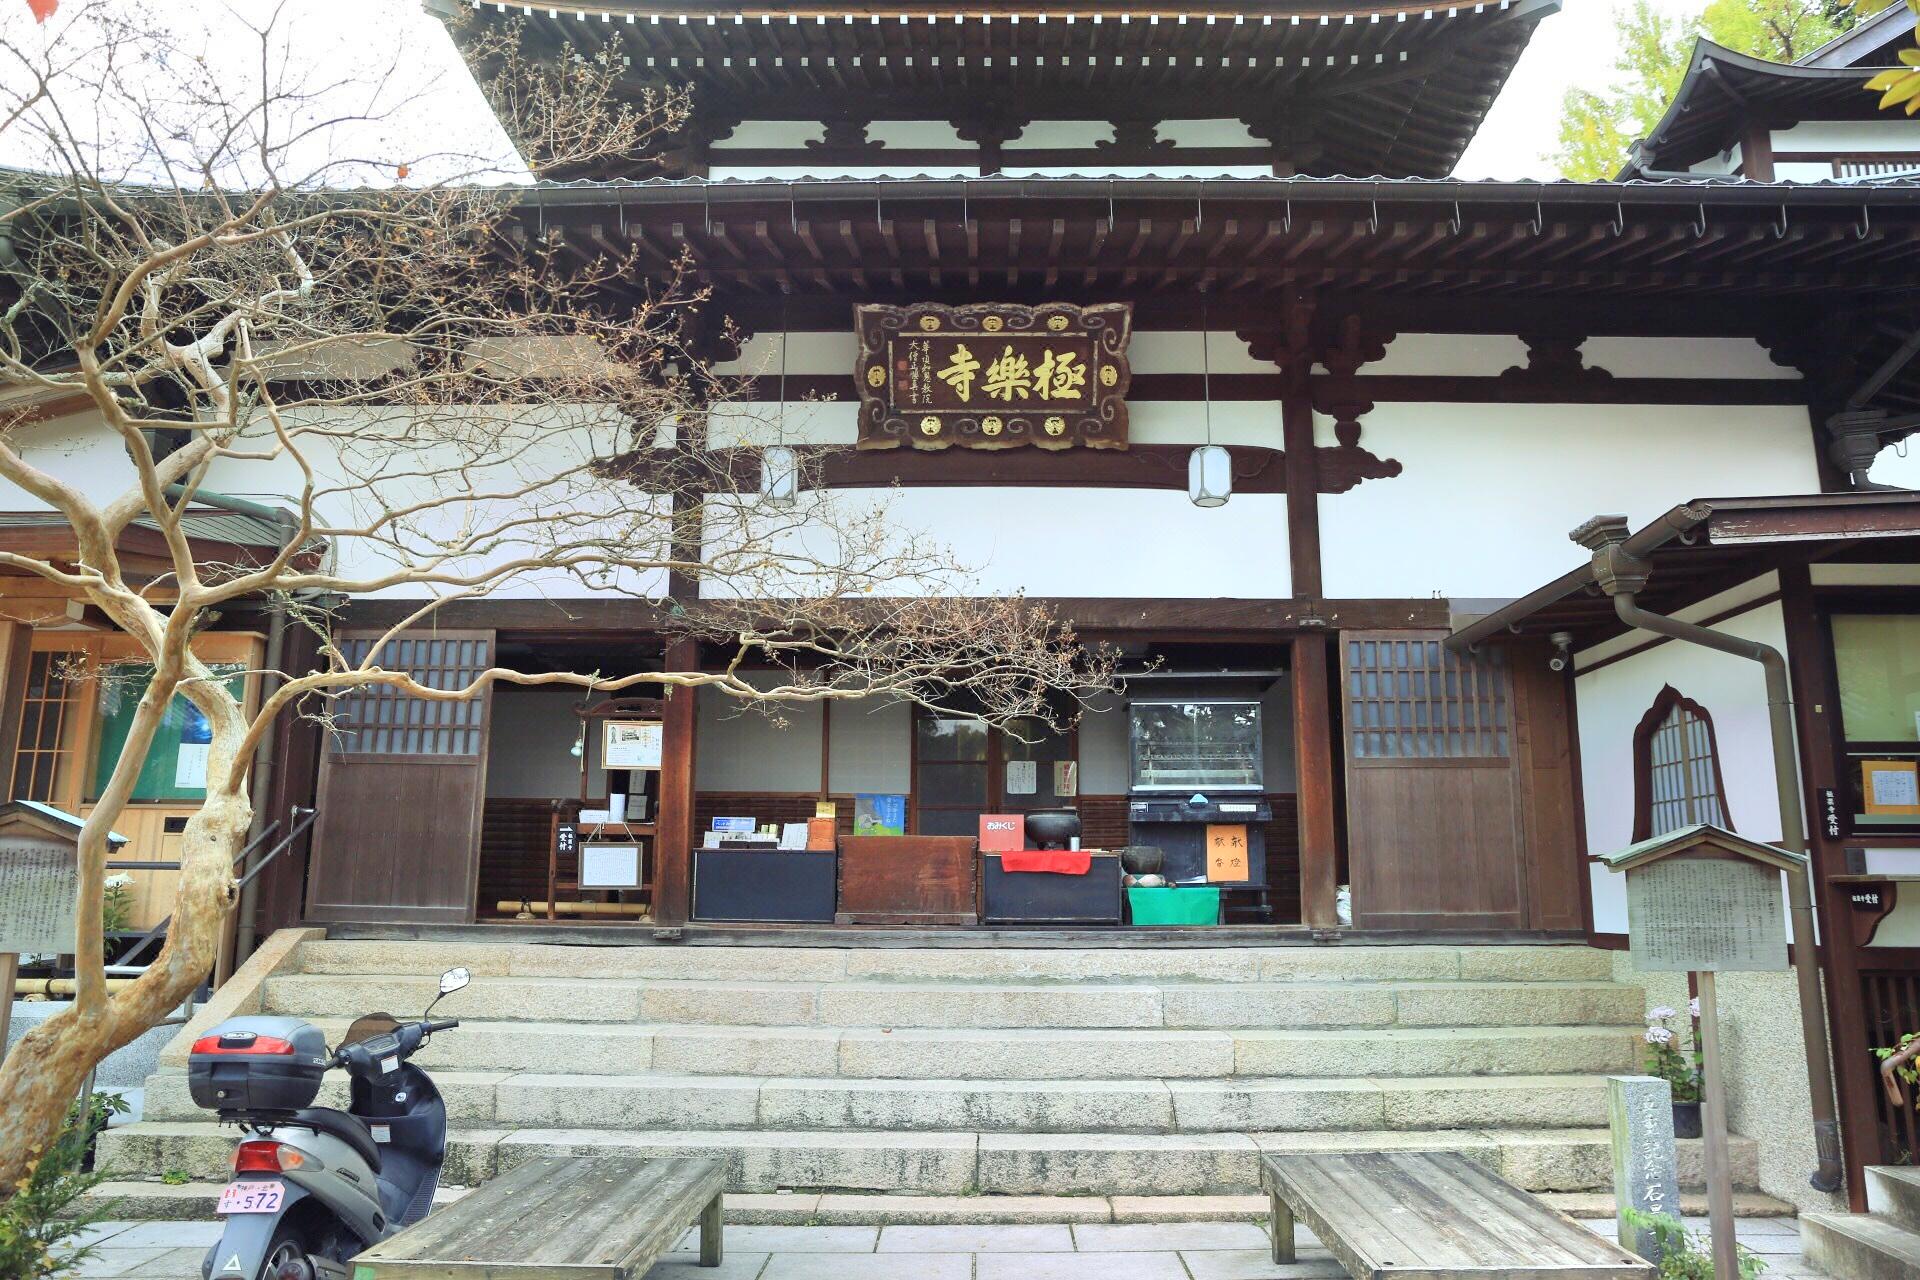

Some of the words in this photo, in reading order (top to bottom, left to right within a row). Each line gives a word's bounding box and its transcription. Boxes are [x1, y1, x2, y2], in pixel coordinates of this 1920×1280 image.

[936, 343, 1087, 403] 極樂寺
[986, 821, 1016, 832] おみくじ
